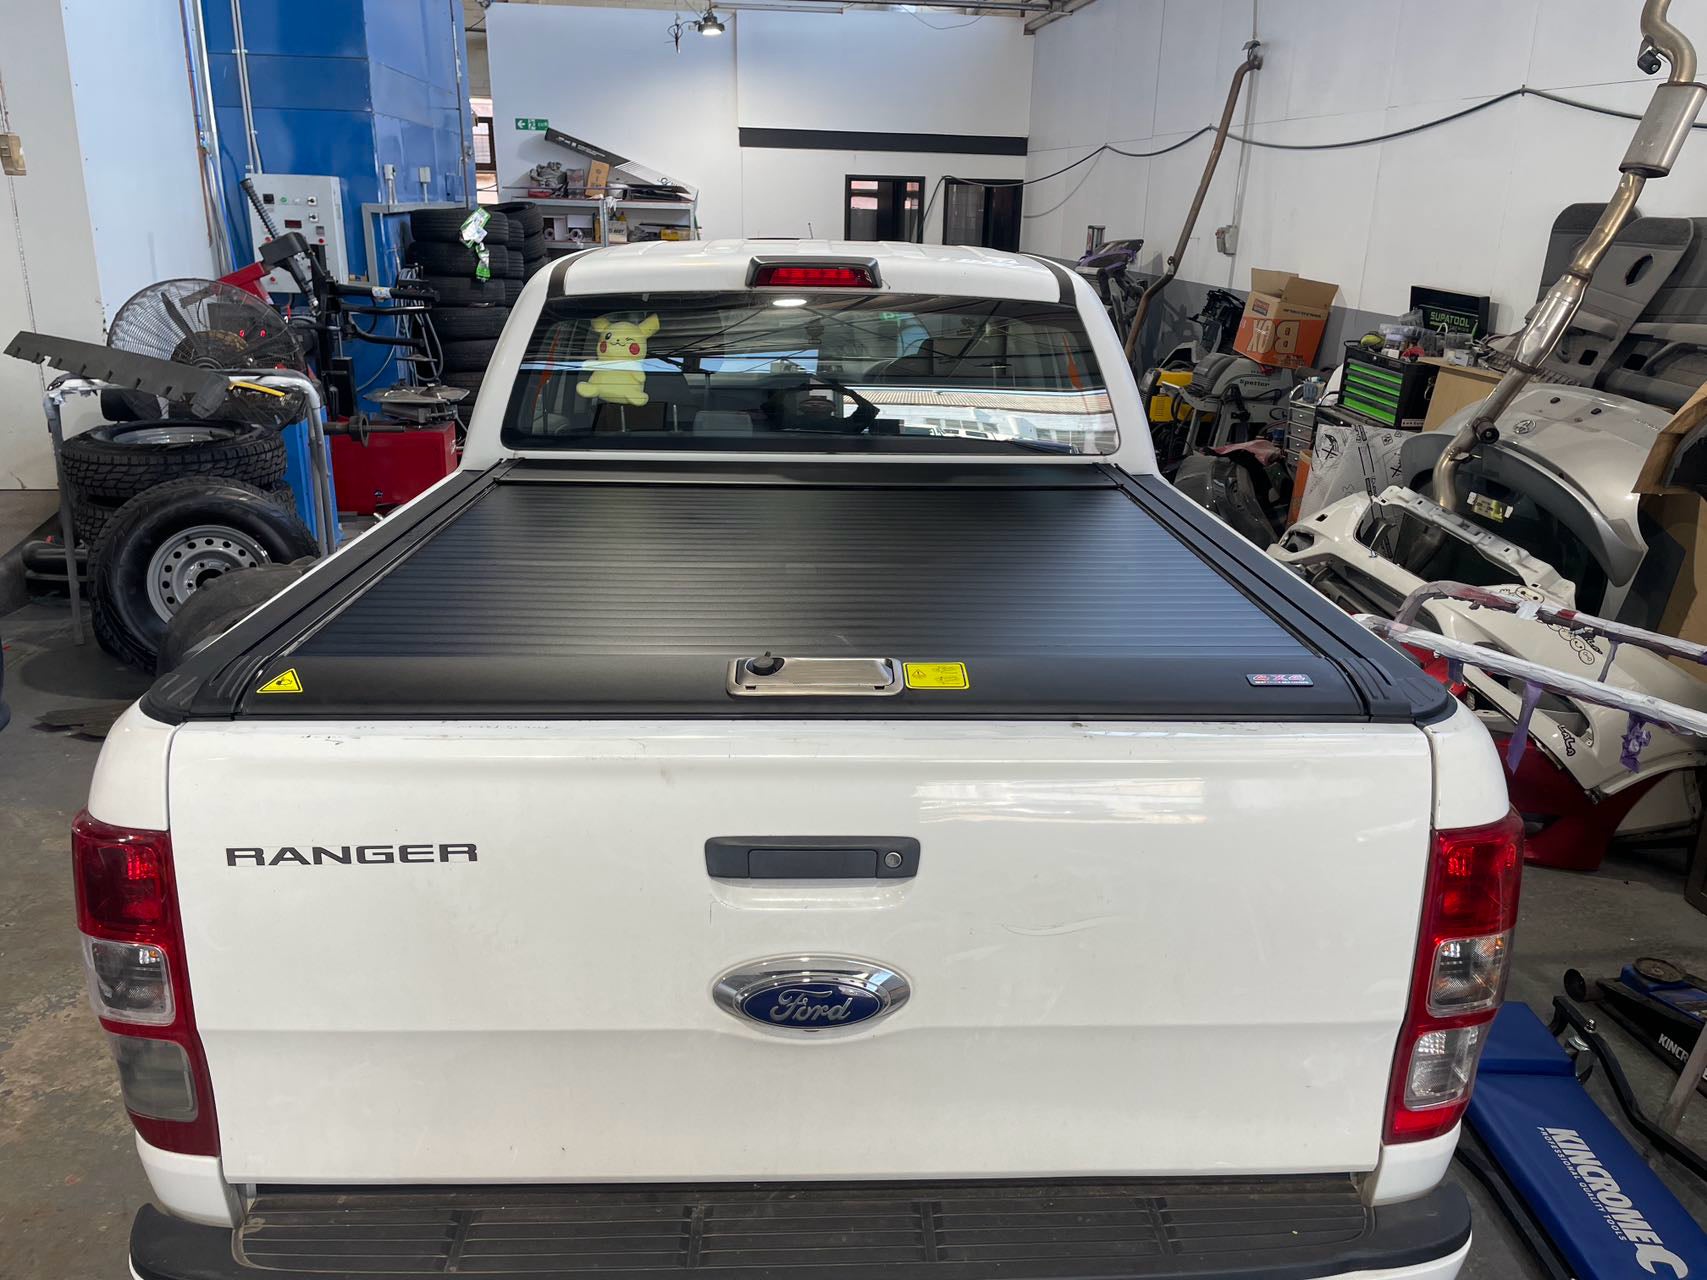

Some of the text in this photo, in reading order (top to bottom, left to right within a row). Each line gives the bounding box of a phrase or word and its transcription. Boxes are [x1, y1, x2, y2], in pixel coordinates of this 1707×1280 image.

[1430, 311, 1470, 327] SUPATOOL
[1247, 319, 1300, 354] BOX
[226, 843, 478, 867] RANGER
[769, 988, 853, 1022] Ford
[1537, 1126, 1628, 1241] PROFESSIONAL QUALITY TOOLS
[1544, 1127, 1665, 1246] KINCROME
